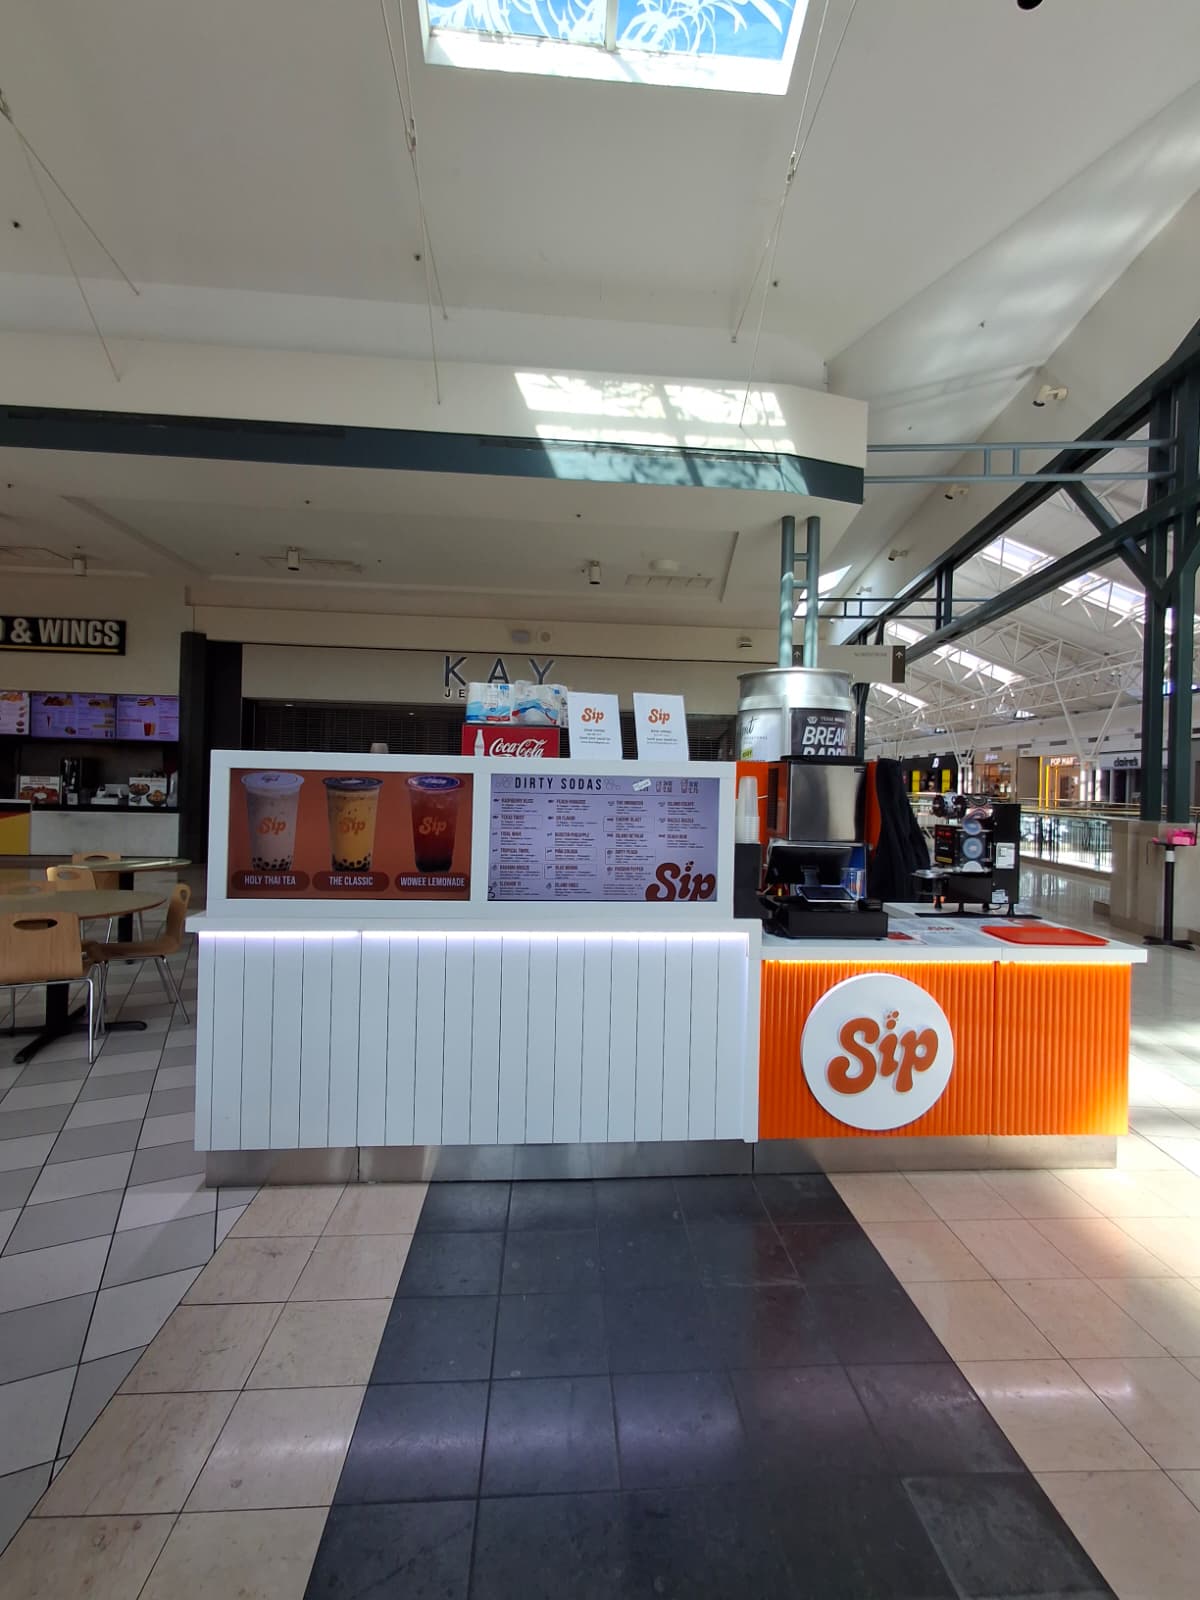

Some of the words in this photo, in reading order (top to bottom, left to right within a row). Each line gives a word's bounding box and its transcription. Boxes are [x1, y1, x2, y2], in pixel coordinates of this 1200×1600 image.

[10, 618, 32, 643] &
[38, 619, 120, 646] WINGS
[445, 656, 554, 687] KAY
[581, 707, 604, 724] Sip
[648, 708, 670, 725] Sip
[515, 777, 553, 790] DIRTY
[560, 778, 602, 791] SODAS
[260, 816, 286, 836] Sip
[340, 816, 366, 836] Sip
[420, 815, 446, 835] Sip
[244, 875, 262, 885] HOLY
[264, 876, 281, 886] THAI
[282, 876, 296, 886] TEA
[329, 876, 343, 886] THE
[344, 876, 373, 886] CLASSIC
[400, 876, 426, 887] WOWEE
[428, 877, 465, 887] LEMONADE
[645, 861, 716, 901] Sip
[827, 1010, 939, 1094] Sip
